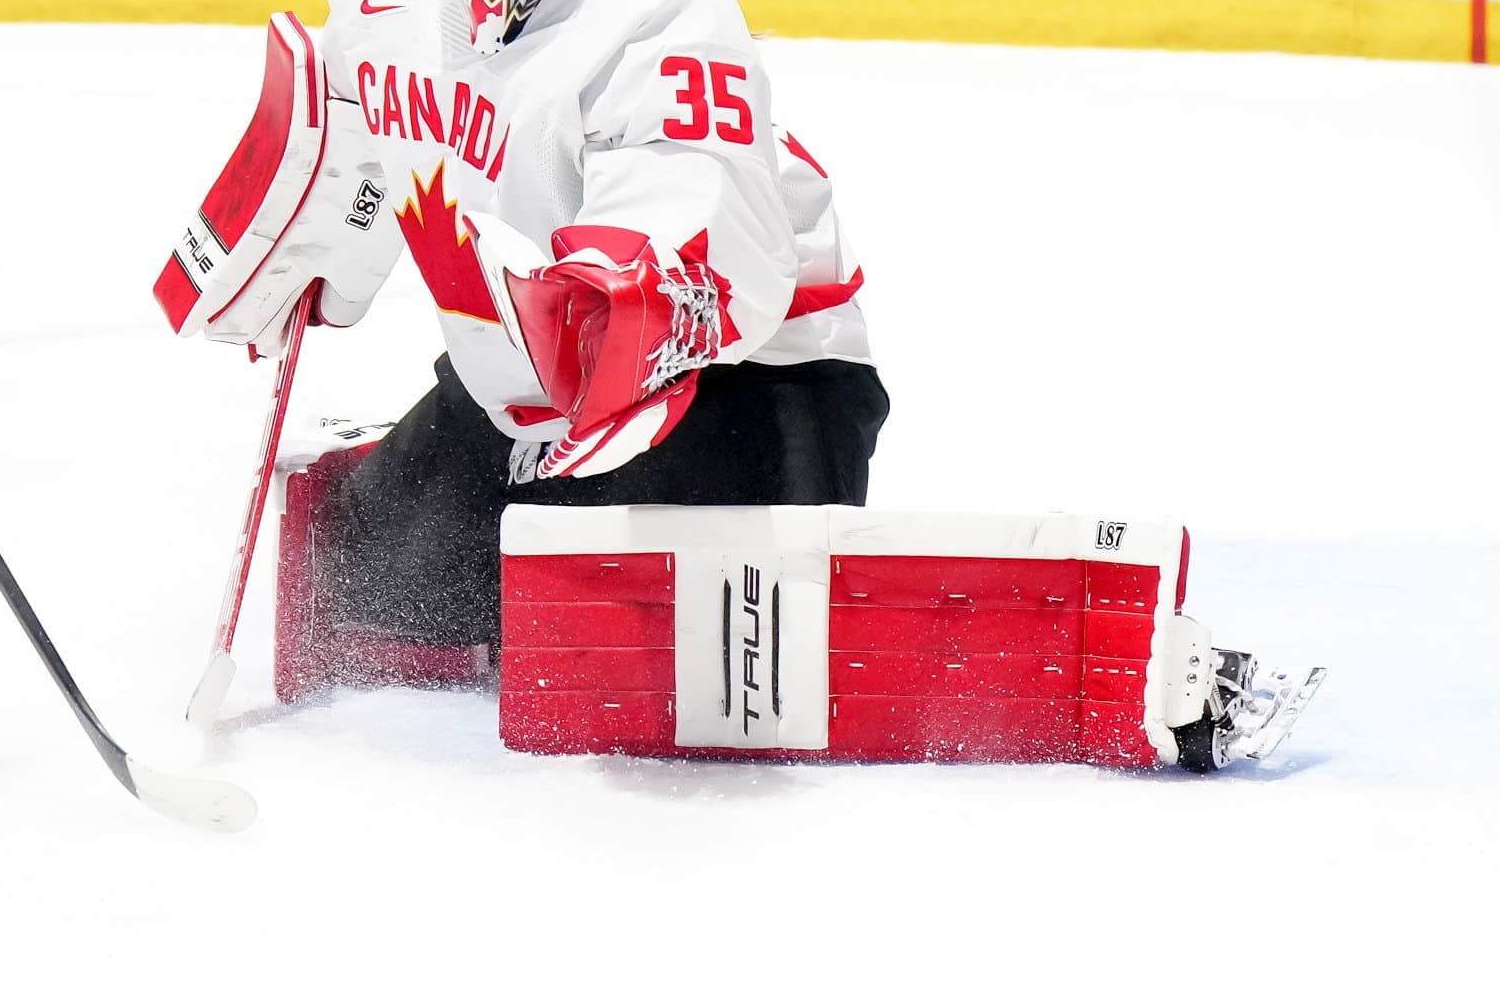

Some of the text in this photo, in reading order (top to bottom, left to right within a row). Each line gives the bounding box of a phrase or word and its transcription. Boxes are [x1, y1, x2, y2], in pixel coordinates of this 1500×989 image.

[660, 56, 754, 146] 35
[181, 226, 214, 274] TRUE
[743, 563, 761, 738] TRUE
